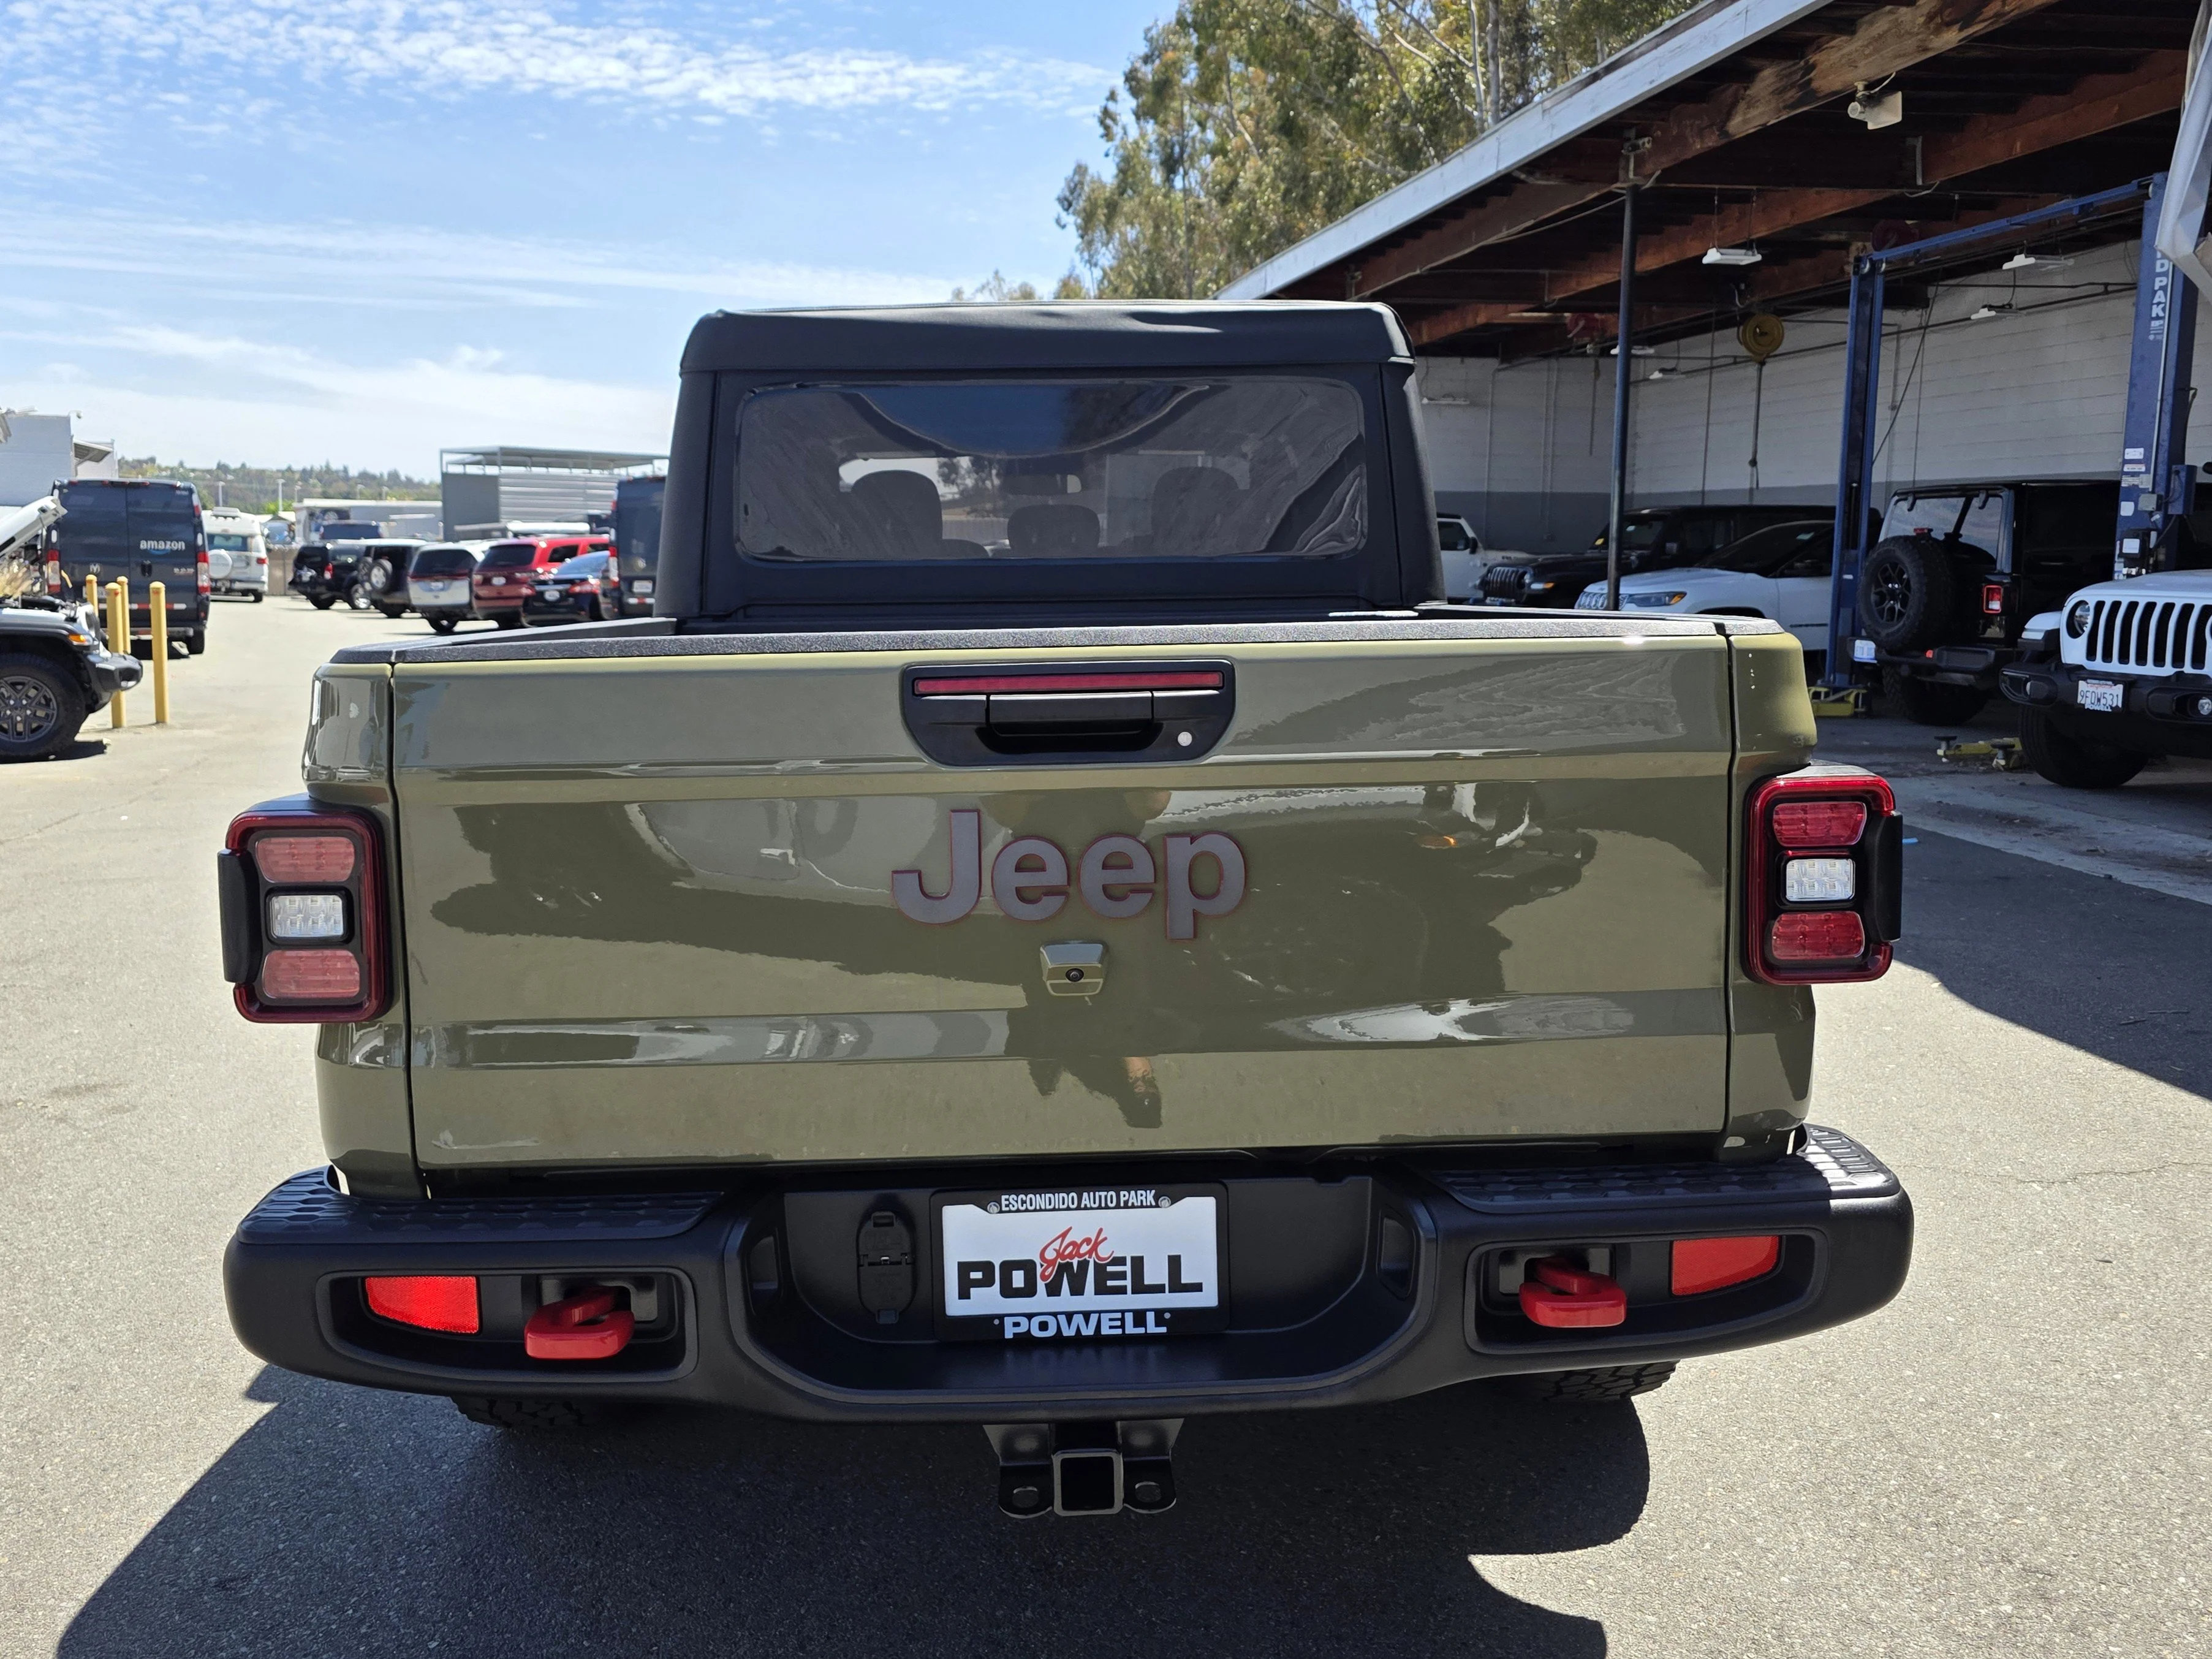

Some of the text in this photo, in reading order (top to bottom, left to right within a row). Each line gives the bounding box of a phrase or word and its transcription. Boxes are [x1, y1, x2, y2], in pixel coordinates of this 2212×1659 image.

[140, 539, 186, 551] amazon
[892, 808, 1246, 940] Jeep
[1001, 1189, 1156, 1212] ESCONDIDO AUTO PARK
[1039, 1226, 1115, 1283] Jack
[957, 1255, 1203, 1300] POWELL
[1004, 1311, 1167, 1339] POWELL
